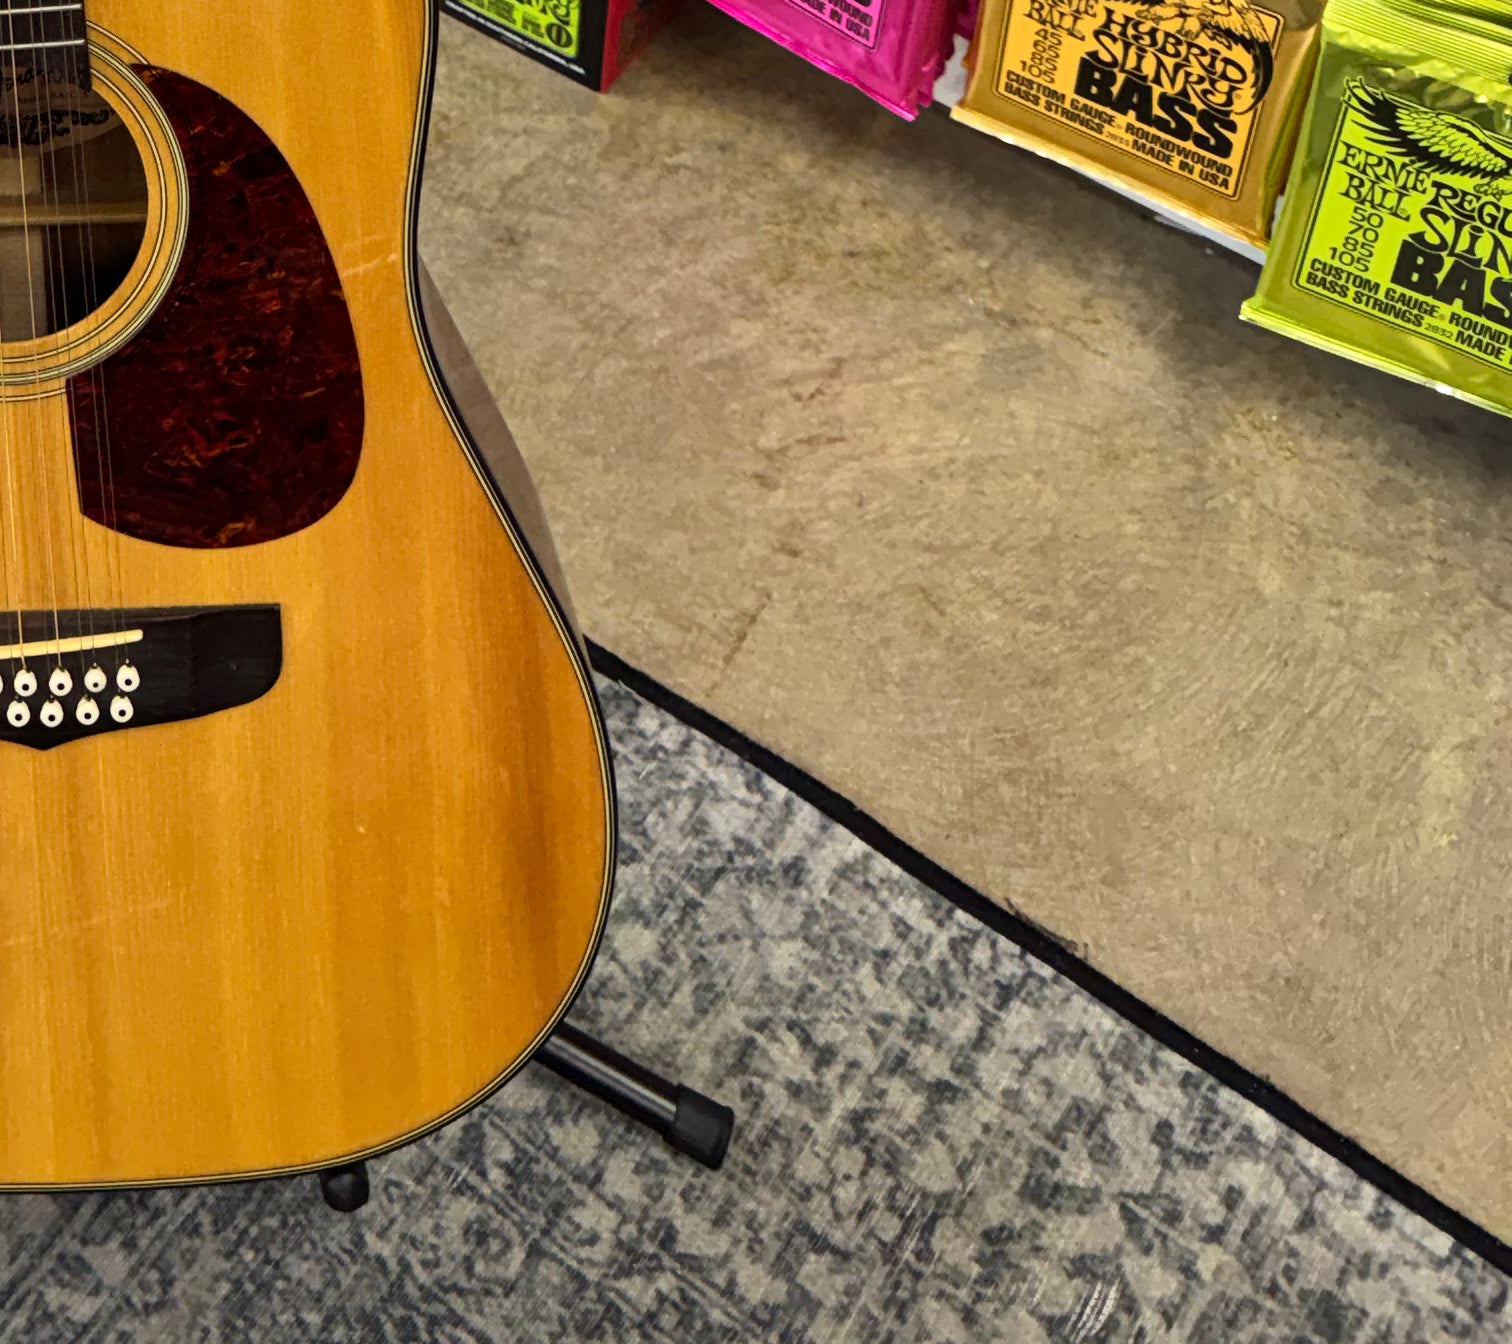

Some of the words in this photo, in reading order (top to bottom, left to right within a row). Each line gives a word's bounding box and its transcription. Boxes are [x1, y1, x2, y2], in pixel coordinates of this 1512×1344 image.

[1096, 12, 1246, 87] HYBRID
[1073, 57, 1236, 160] BASS
[1126, 124, 1232, 177] ROUNDWOUND
